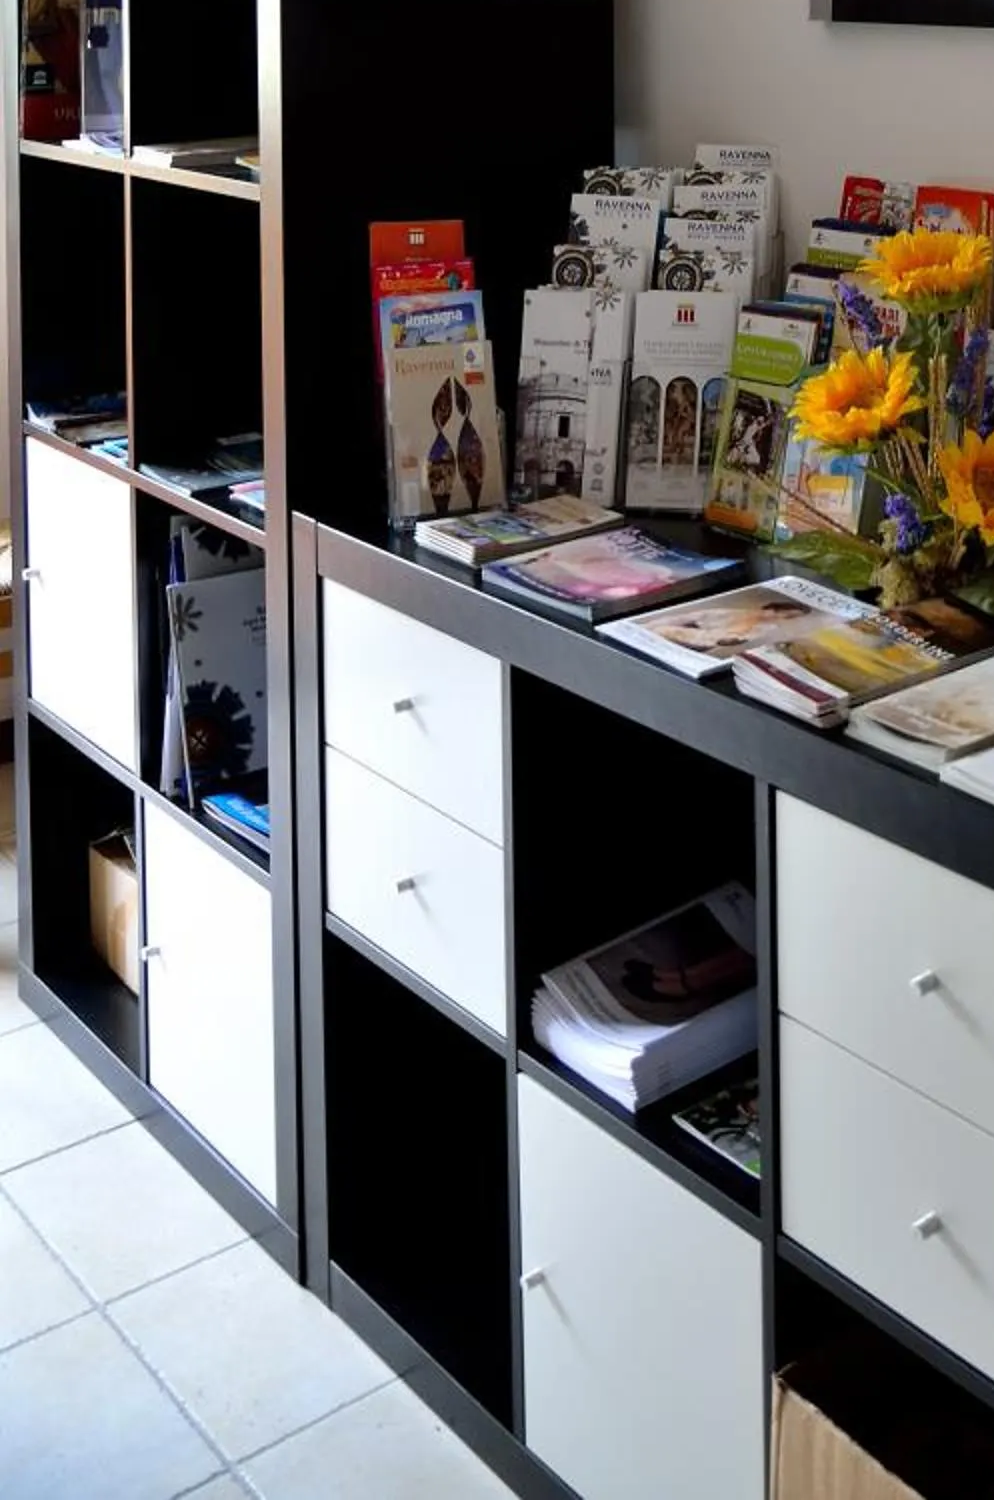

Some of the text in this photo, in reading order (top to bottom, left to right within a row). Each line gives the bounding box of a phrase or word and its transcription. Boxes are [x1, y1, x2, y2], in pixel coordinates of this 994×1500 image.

[719, 149, 771, 161] RAVENNA
[701, 190, 757, 202] RAVENNA
[595, 200, 651, 211] RAVENNA
[688, 221, 745, 233] RAVENNA
[395, 356, 455, 375] Ravenna
